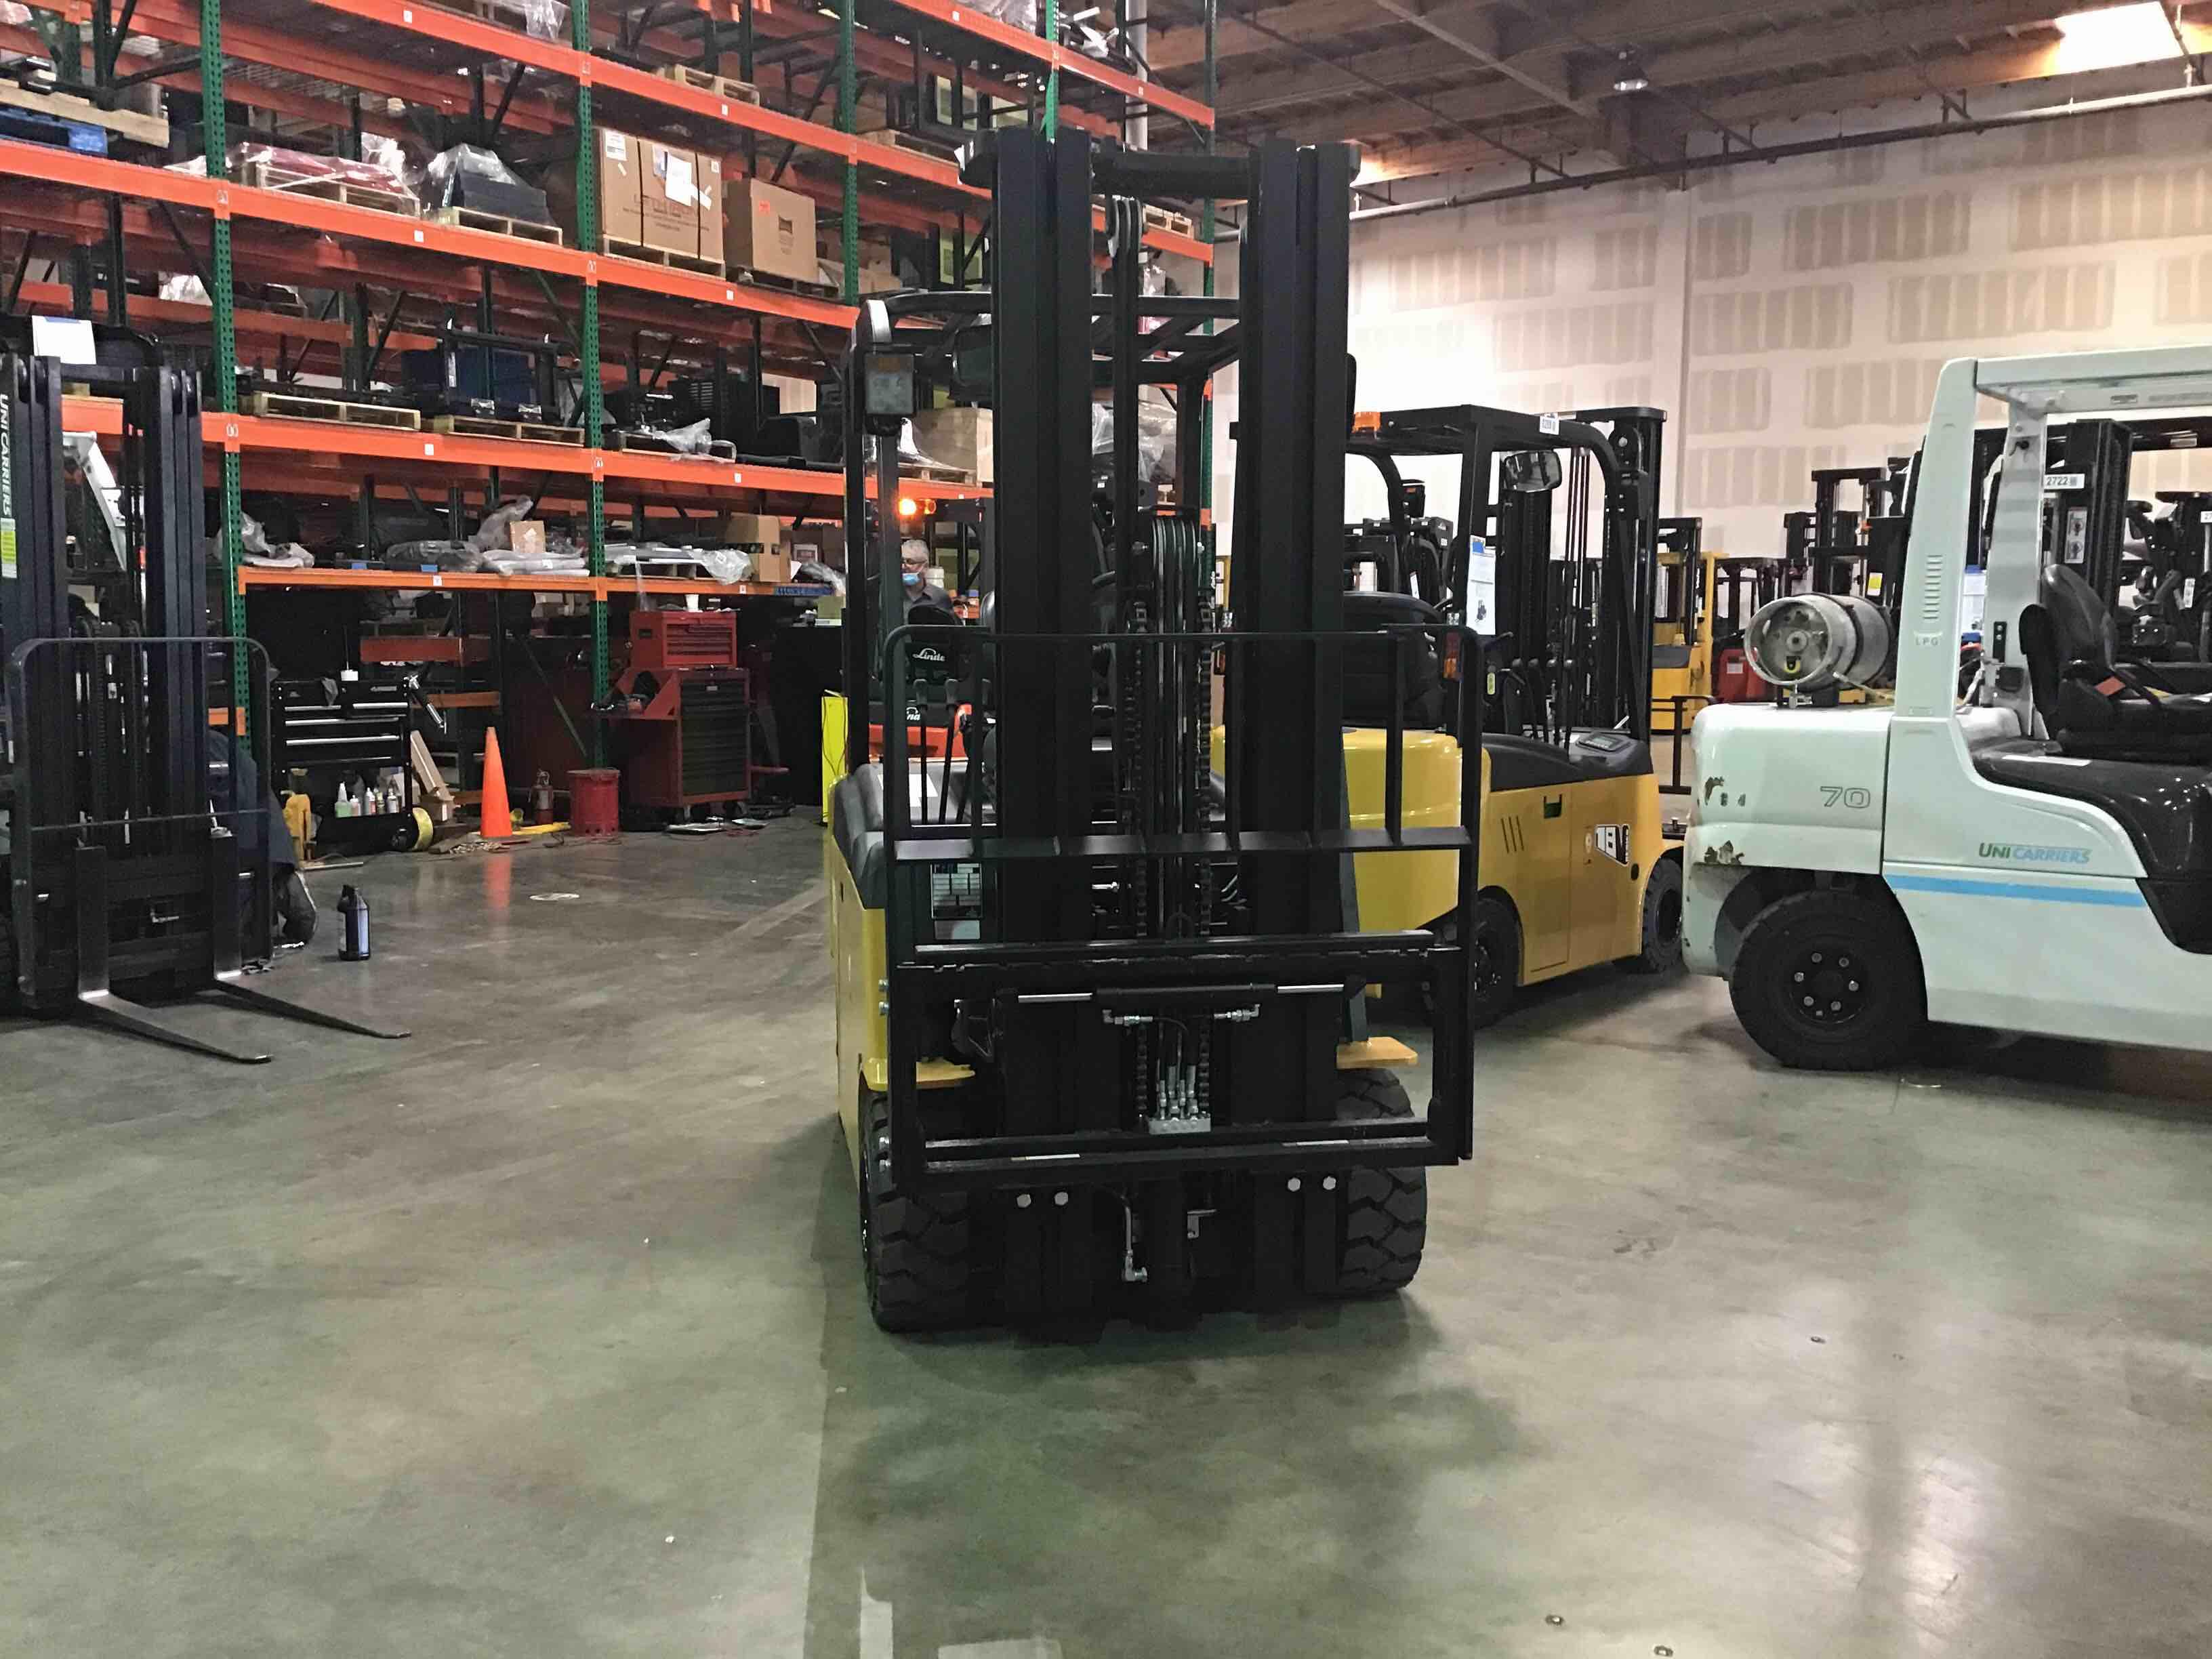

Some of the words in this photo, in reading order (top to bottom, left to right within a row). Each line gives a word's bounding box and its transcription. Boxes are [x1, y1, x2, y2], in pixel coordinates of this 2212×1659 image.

[1916, 636, 1939, 646] LPG
[912, 648, 945, 661] Linde
[1820, 786, 1870, 808] 70
